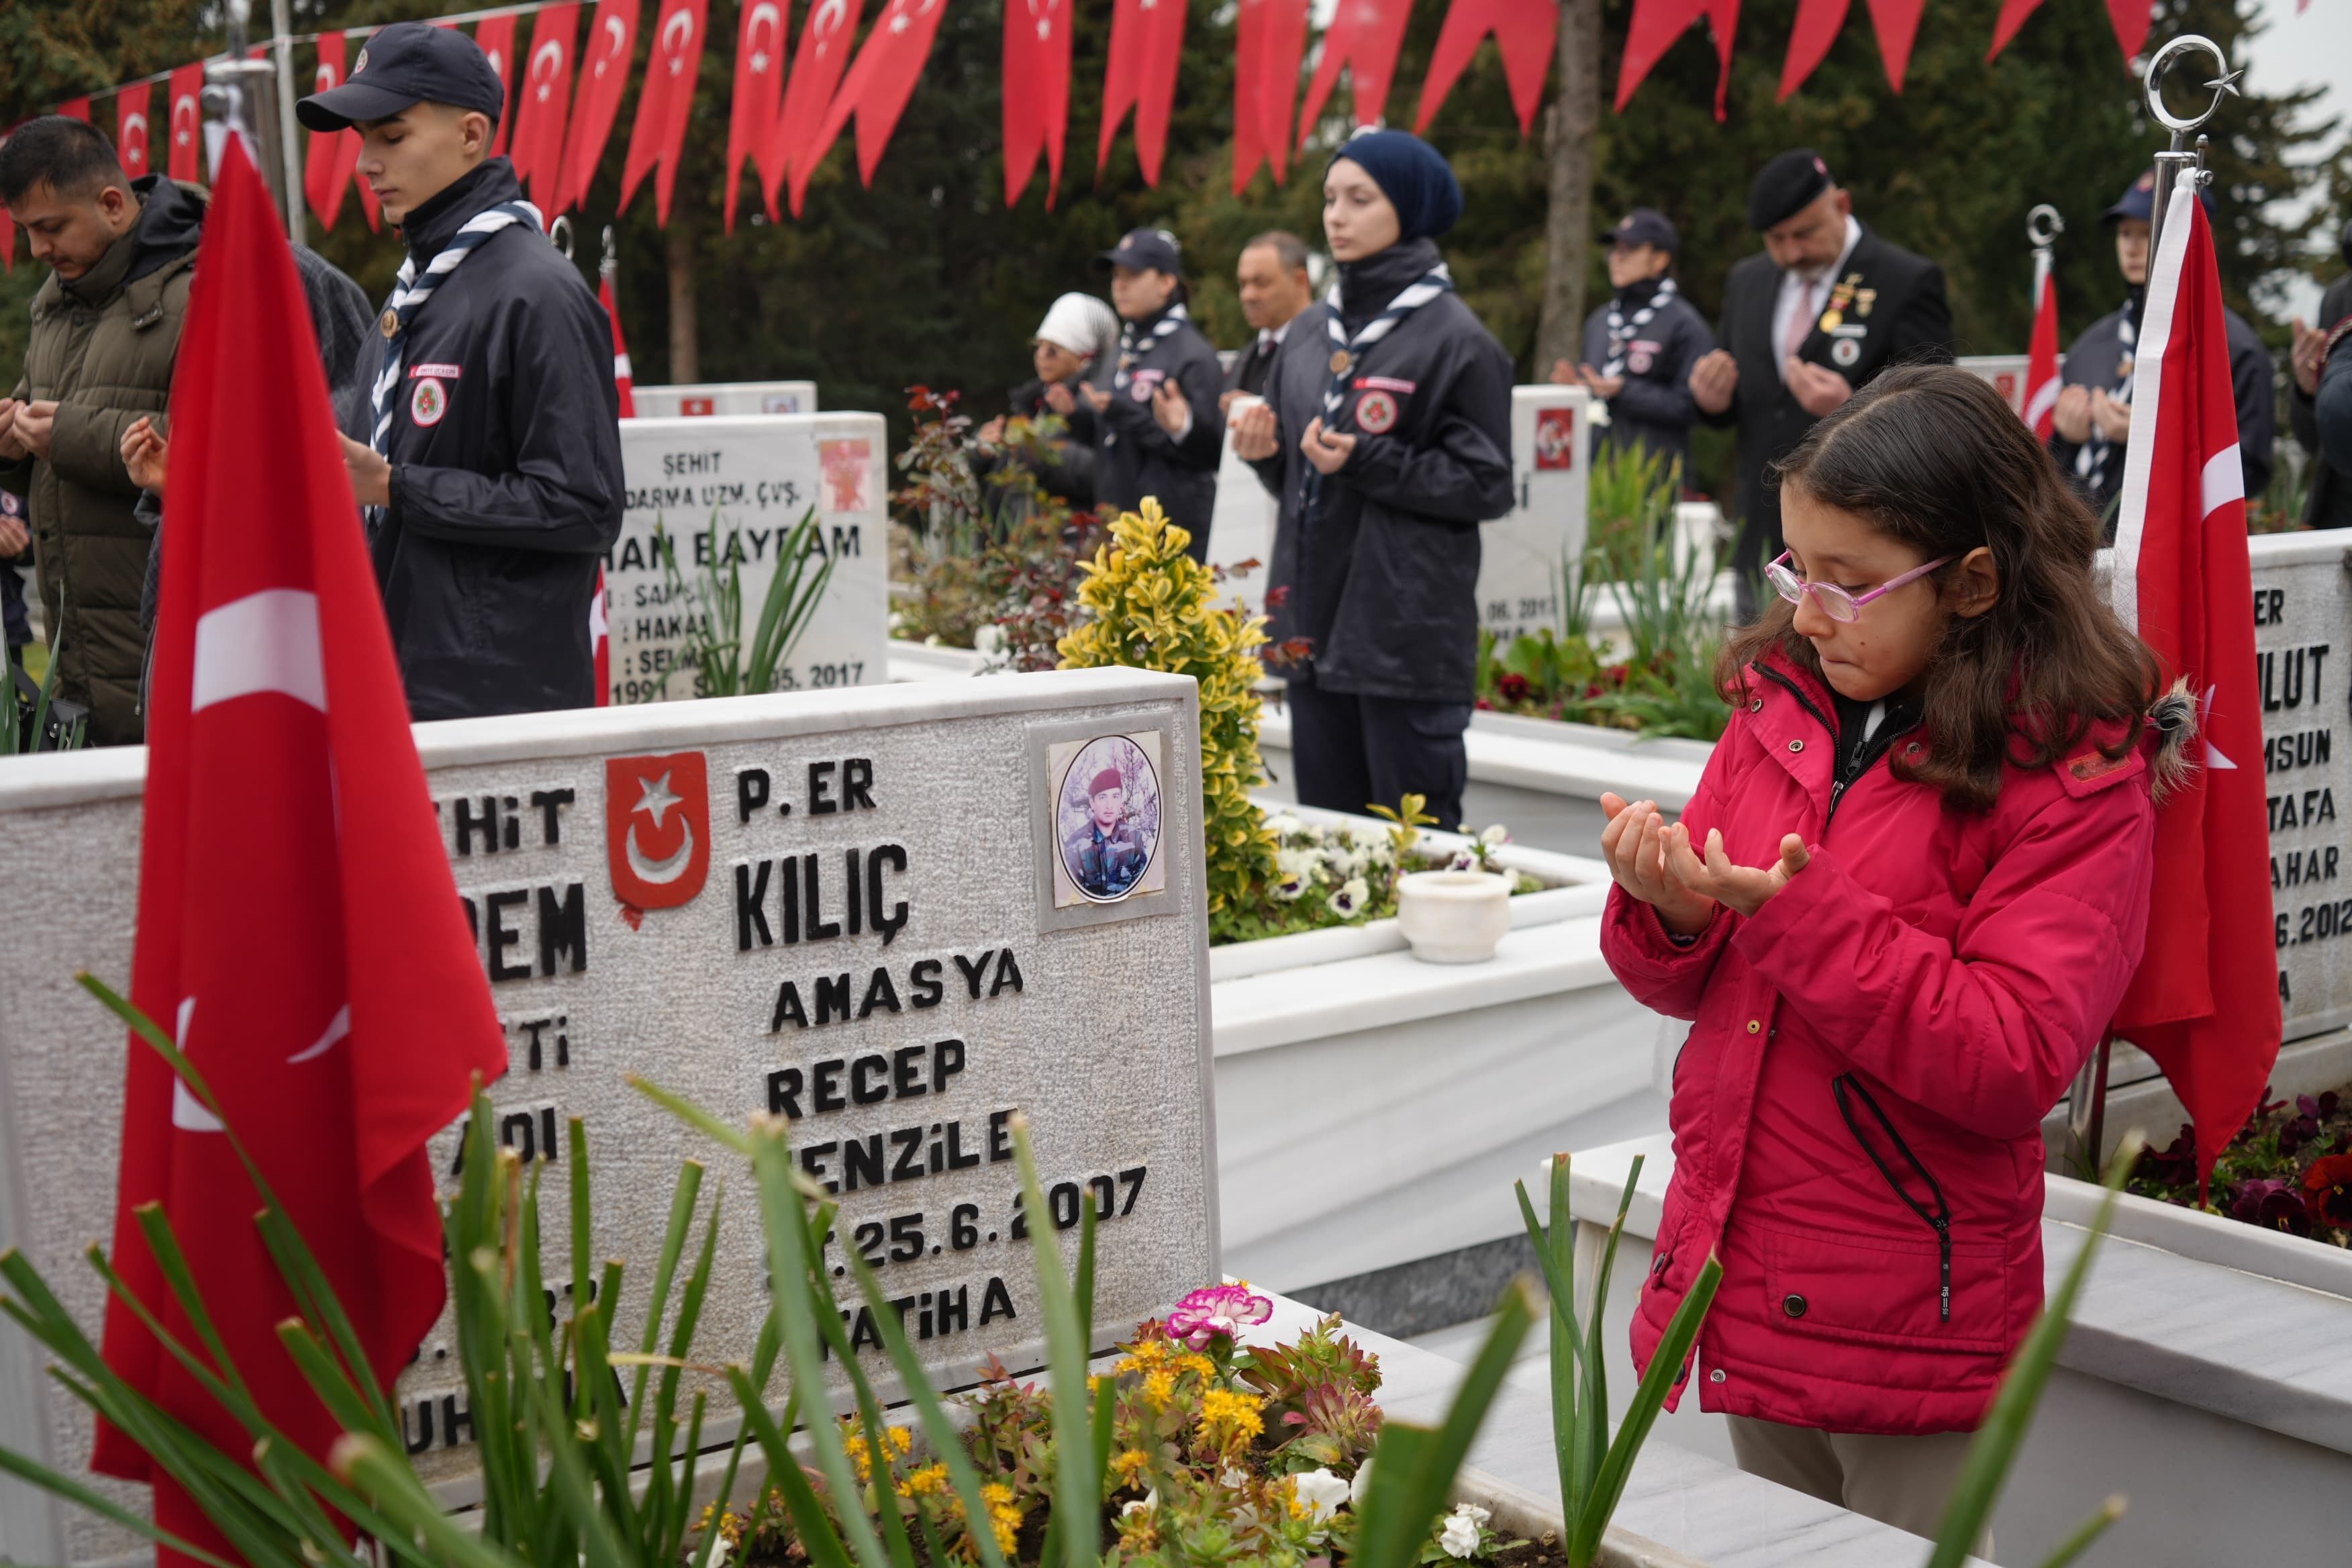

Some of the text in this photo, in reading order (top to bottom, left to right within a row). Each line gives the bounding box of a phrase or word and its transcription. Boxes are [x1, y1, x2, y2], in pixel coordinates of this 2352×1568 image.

[624, 487, 694, 509] DARMA
[810, 660, 865, 687] 2017
[735, 843, 909, 952] KILIÇ
[771, 947, 1024, 1033] AMASYA
[768, 1038, 966, 1120] RECEP
